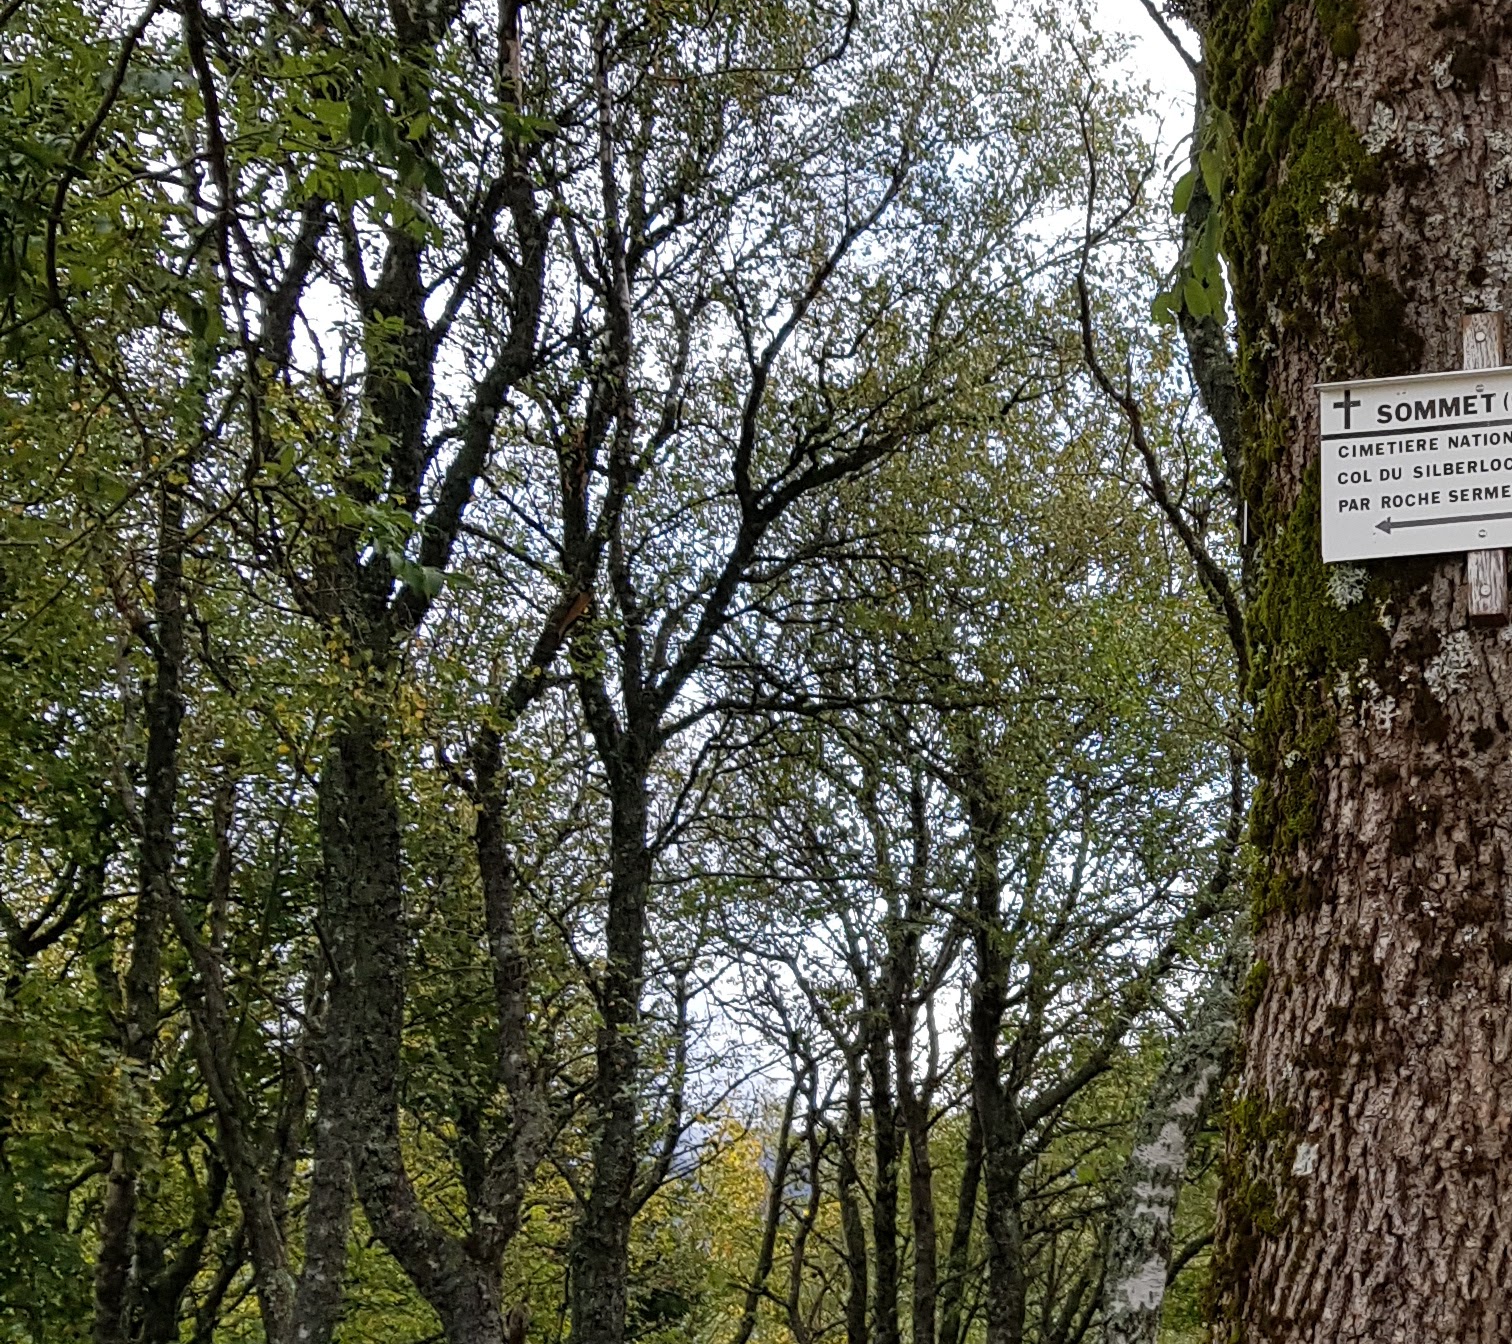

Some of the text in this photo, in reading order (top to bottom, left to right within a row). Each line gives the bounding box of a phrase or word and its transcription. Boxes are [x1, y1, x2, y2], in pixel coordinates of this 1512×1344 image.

[1376, 393, 1497, 424] SOMMET
[1338, 438, 1439, 459] CIMETIERE
[1337, 470, 1372, 485] COL
[1380, 467, 1402, 481] DU
[1339, 498, 1371, 513] PAR
[1381, 490, 1441, 509] ROCHE
